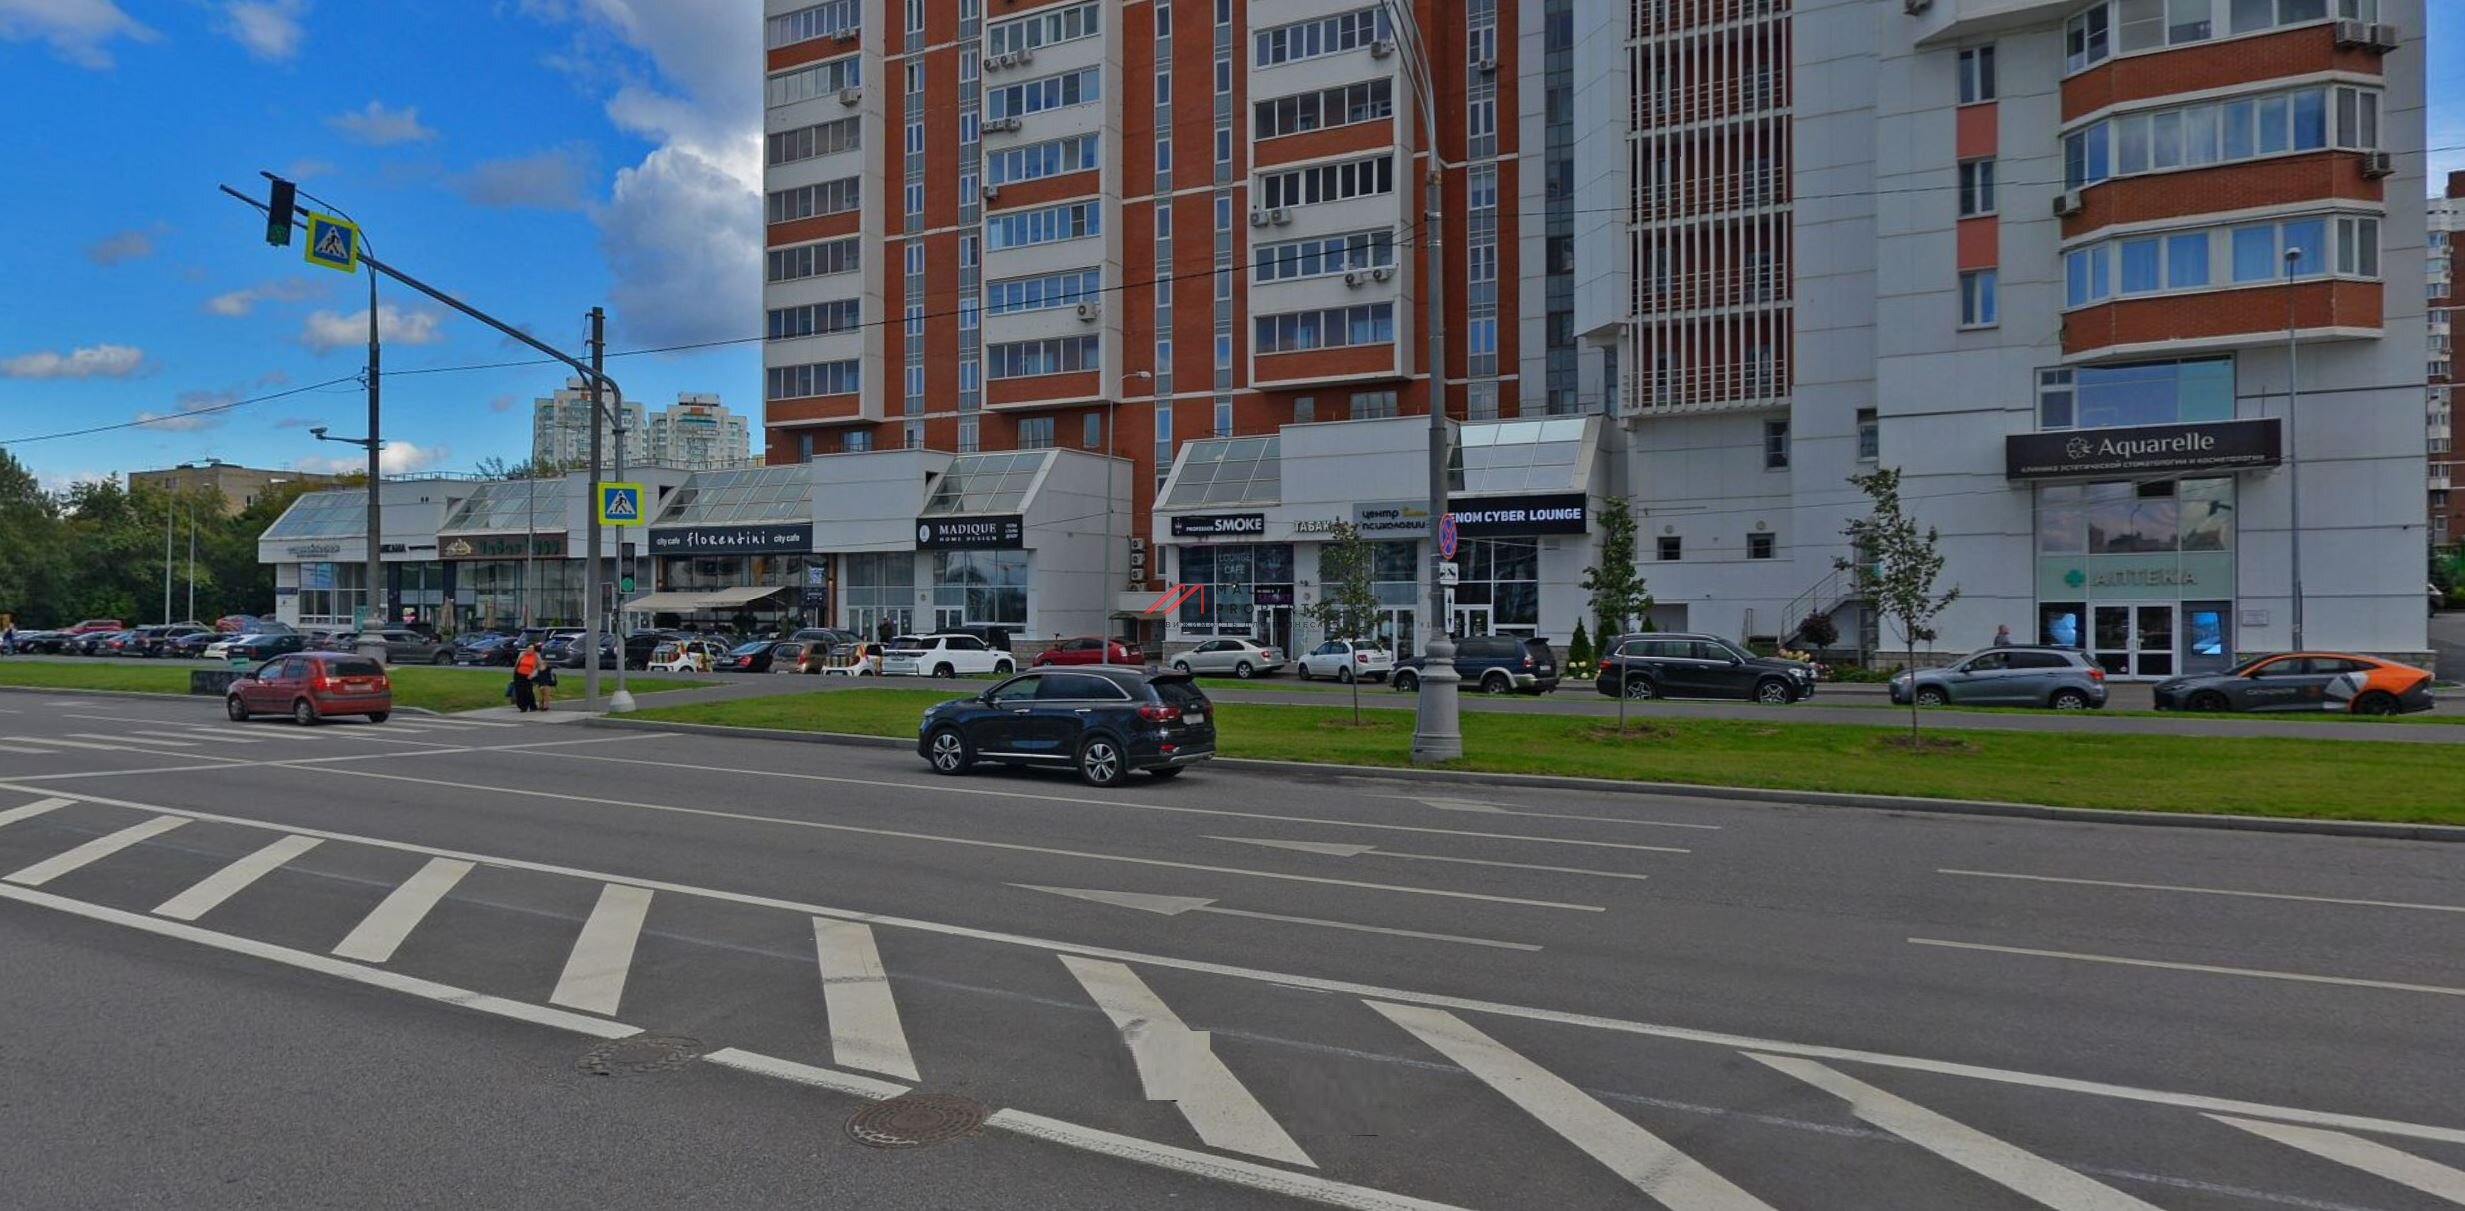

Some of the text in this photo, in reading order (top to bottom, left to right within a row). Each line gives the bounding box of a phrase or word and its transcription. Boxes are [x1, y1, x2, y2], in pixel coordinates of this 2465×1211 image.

[2098, 432, 2215, 459] Aquarelle
[1451, 508, 1582, 524] NOM CYBER LOUNGE
[939, 523, 997, 535] MADIQUE
[1214, 517, 1262, 532] SMOKE
[656, 537, 668, 547] city
[773, 533, 800, 543] city cafe
[1218, 553, 1251, 563] LOUNGE
[1224, 565, 1246, 575] CAFE
[2090, 568, 2199, 587] АПТЕКА
